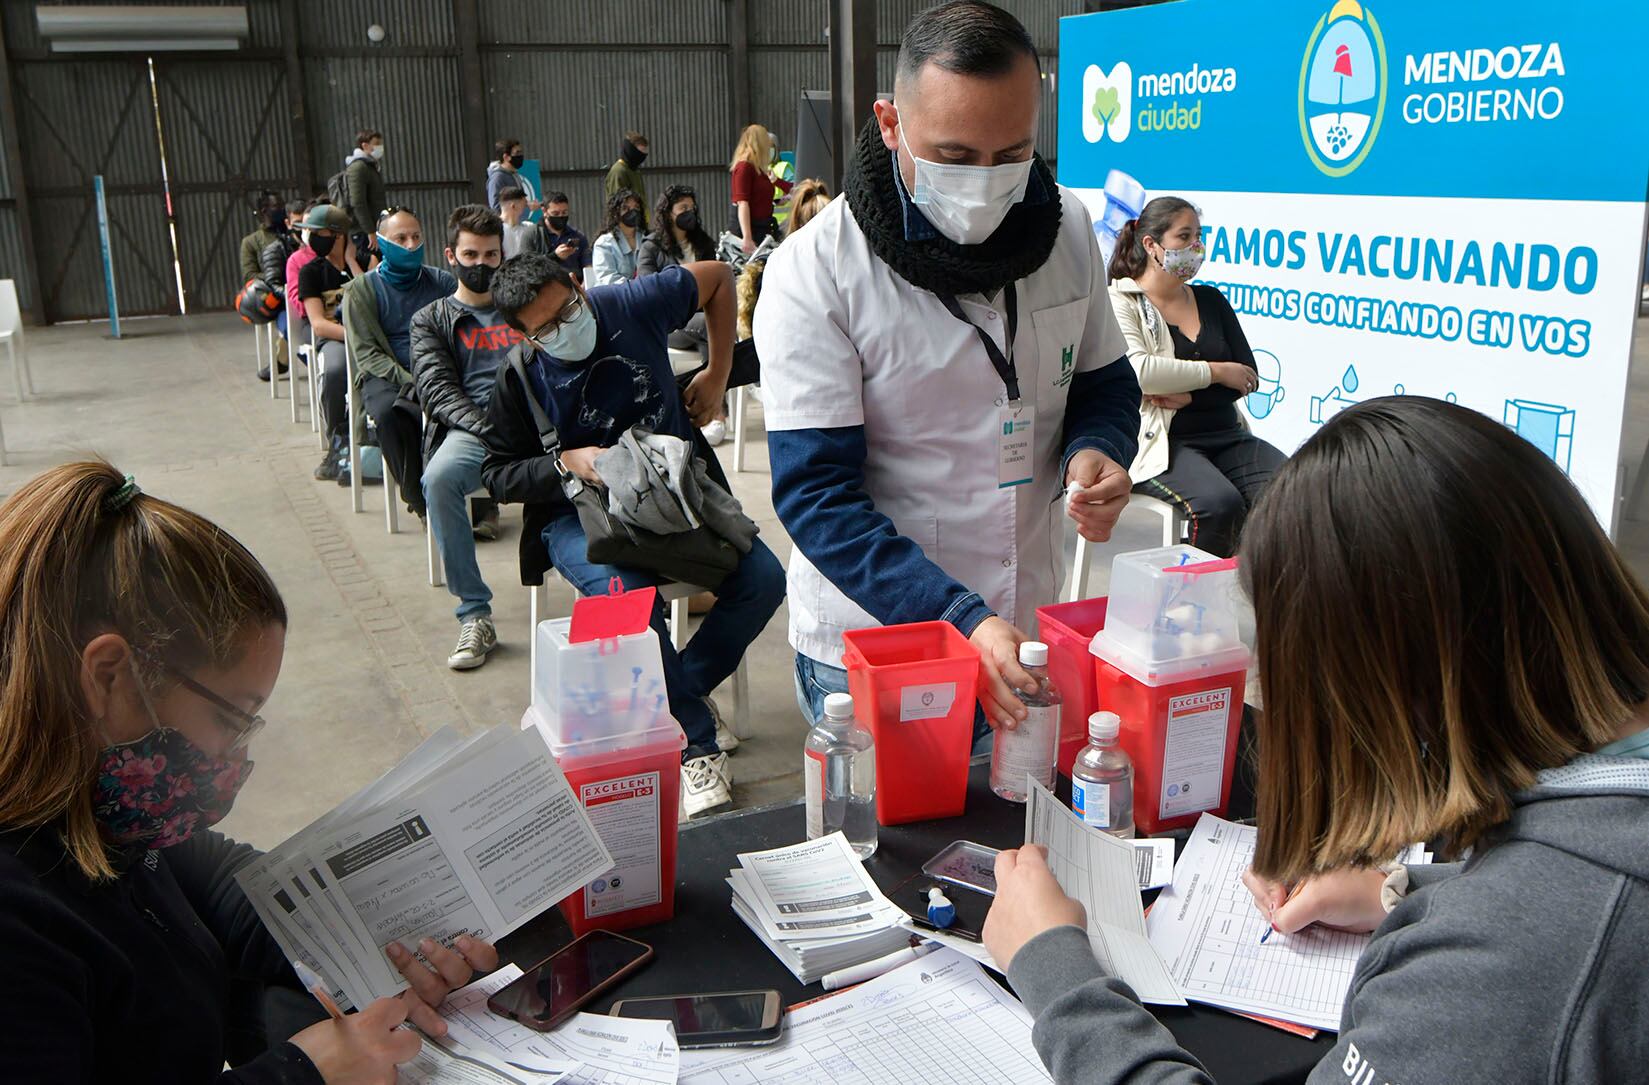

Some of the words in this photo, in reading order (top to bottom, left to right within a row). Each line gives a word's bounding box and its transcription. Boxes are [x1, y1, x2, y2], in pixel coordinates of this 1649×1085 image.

[1138, 63, 1237, 97] mendoza
[1404, 43, 1566, 86] MENDOZA
[1138, 99, 1201, 131] ciudad
[1402, 86, 1565, 124] GOBIERNO
[1316, 231, 1599, 295] VACUNANDO
[1304, 292, 1463, 341] CONFIANDO
[1467, 309, 1514, 348] EN
[1520, 314, 1591, 358] VOS
[1172, 692, 1226, 708] EXCELENT
[585, 777, 653, 796] EXCELENT
